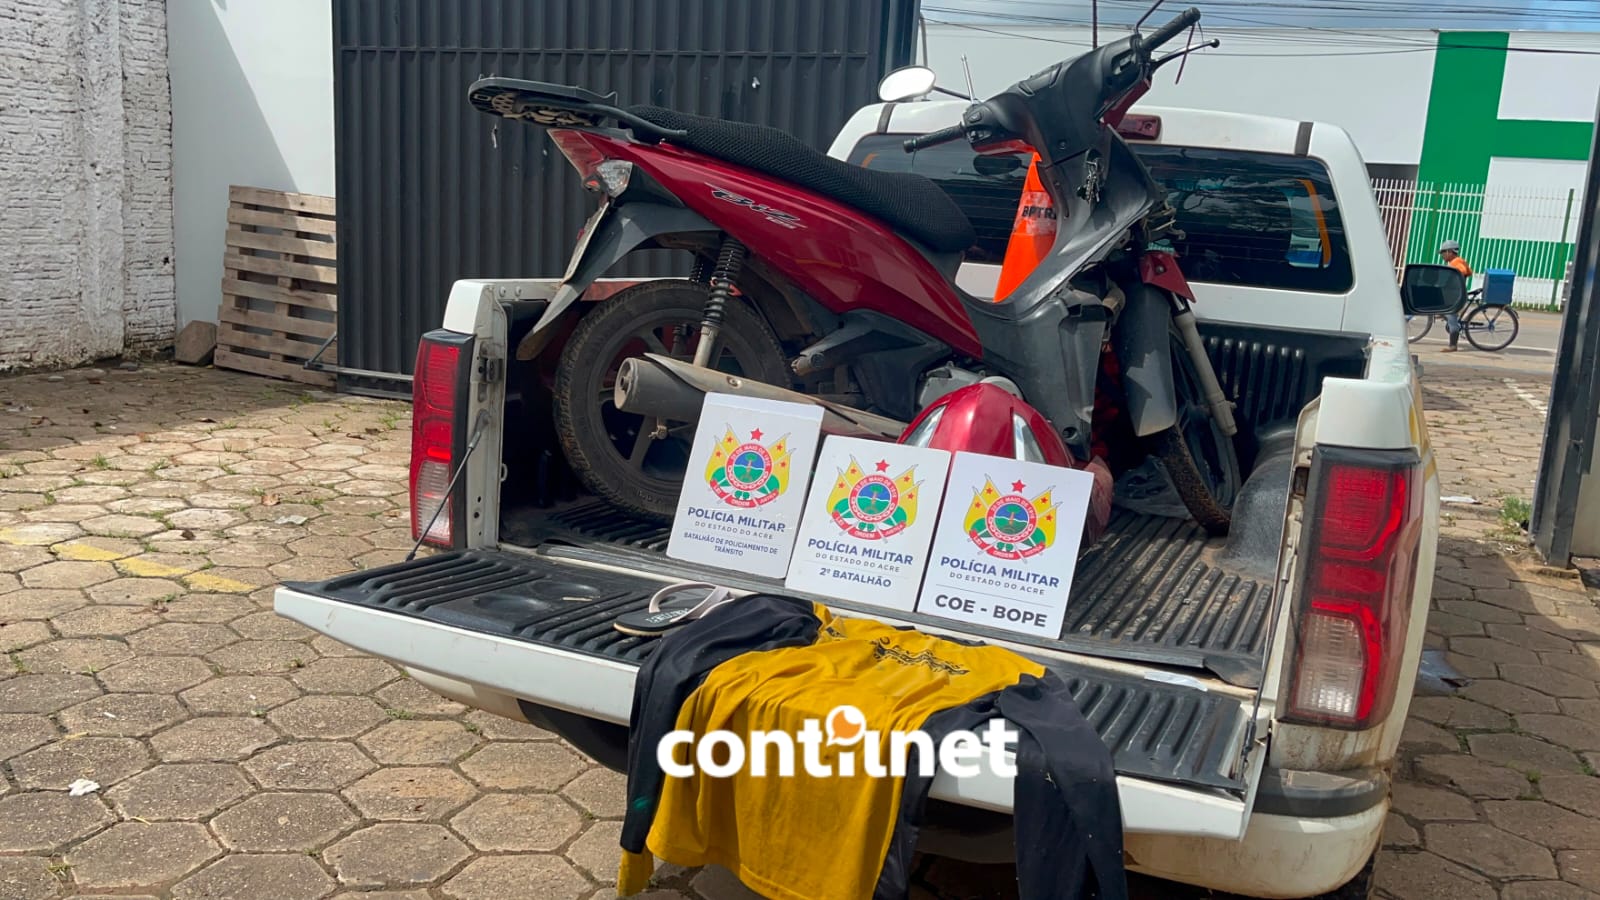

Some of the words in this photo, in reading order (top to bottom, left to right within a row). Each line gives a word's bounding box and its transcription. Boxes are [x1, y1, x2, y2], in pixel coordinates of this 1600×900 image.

[708, 524, 738, 534] ESTADO
[753, 532, 773, 540] ACRE
[738, 516, 786, 532] MILITAR
[684, 532, 714, 543] BATALHÃO
[724, 540, 768, 552] POLICIAMENTO
[714, 546, 744, 556] TRÂNSITO
[808, 538, 858, 556] POLÍCIA
[861, 548, 914, 565] MILITAR
[830, 555, 862, 566] ESTADO
[878, 564, 900, 572] ACRE
[940, 556, 996, 576] POLÍCIA
[1001, 568, 1060, 588] MILITAR
[832, 570, 892, 588] BATALHÃO
[950, 572, 962, 580] DO
[965, 574, 1000, 586] ESTADO
[1020, 586, 1045, 596] ACRE
[935, 594, 976, 613] COE
[992, 605, 1048, 627] BOPE
